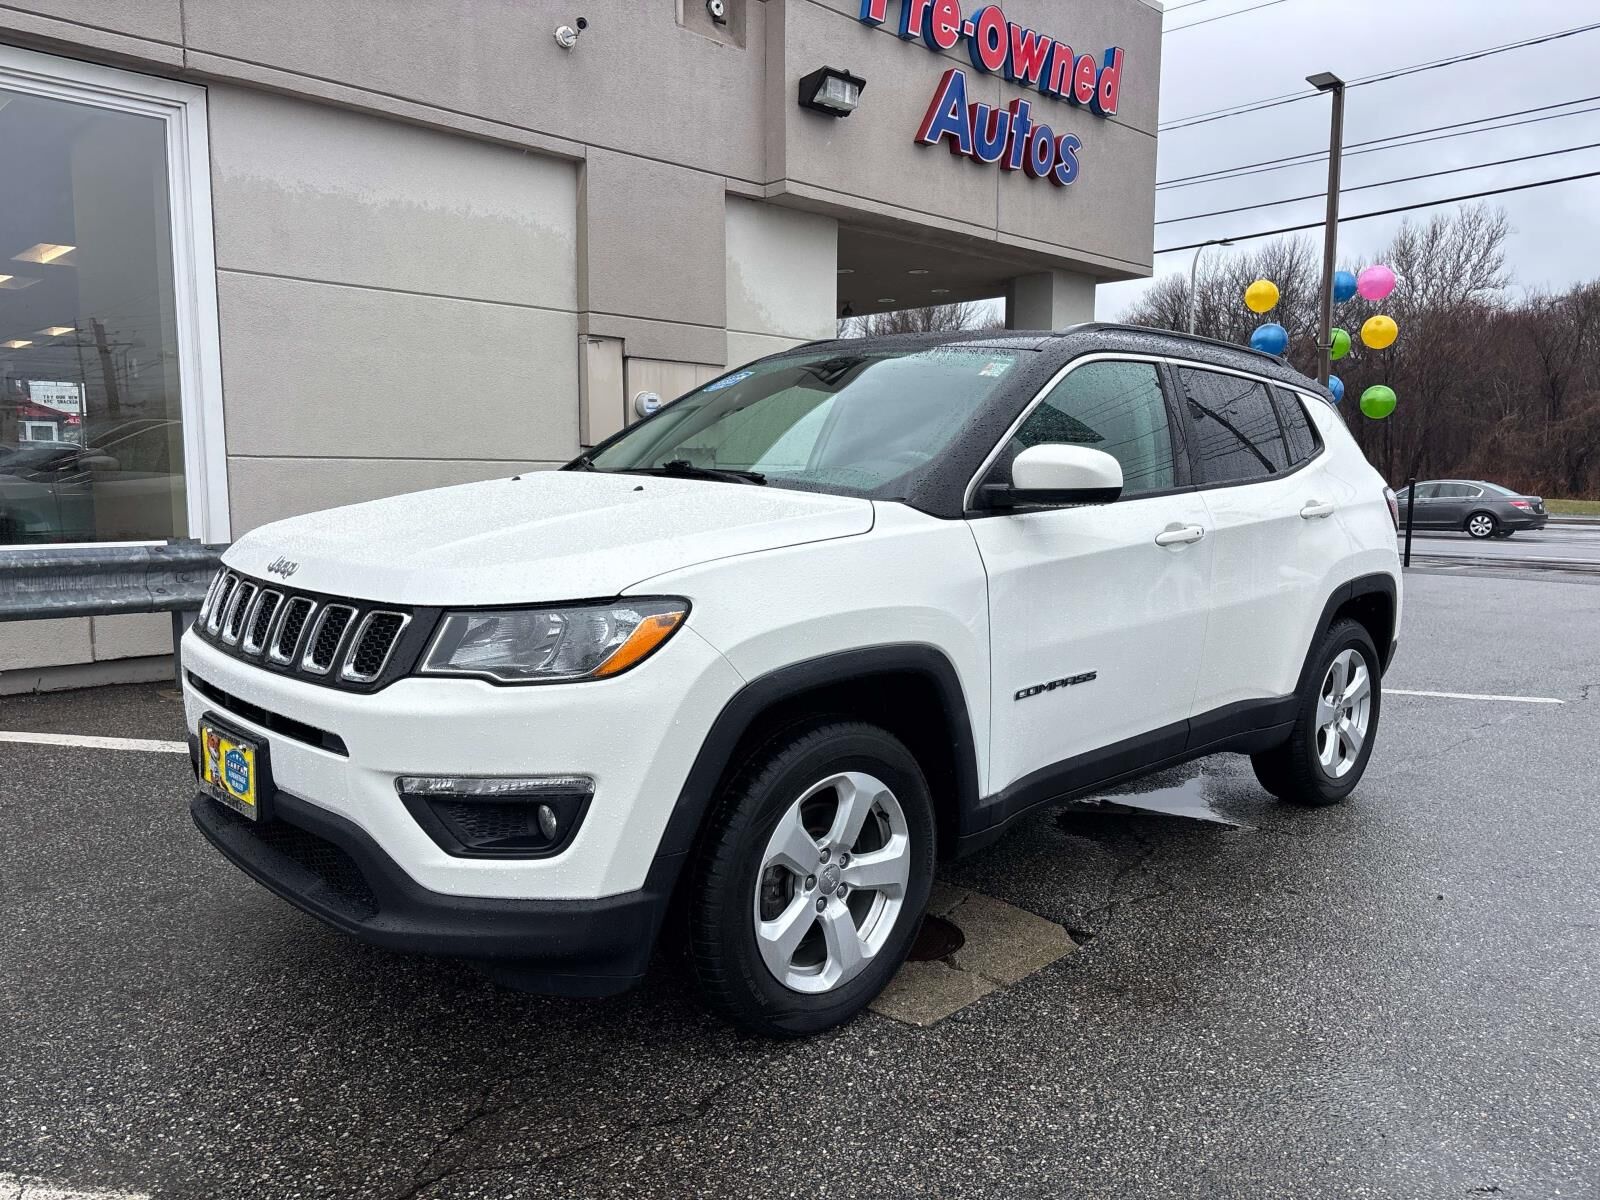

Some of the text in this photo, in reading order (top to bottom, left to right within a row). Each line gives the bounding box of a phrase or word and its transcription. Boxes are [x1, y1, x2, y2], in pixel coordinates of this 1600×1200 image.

[915, 68, 1083, 187] Autos
[267, 555, 300, 580] Jeep
[1014, 670, 1098, 701] COMPASS
